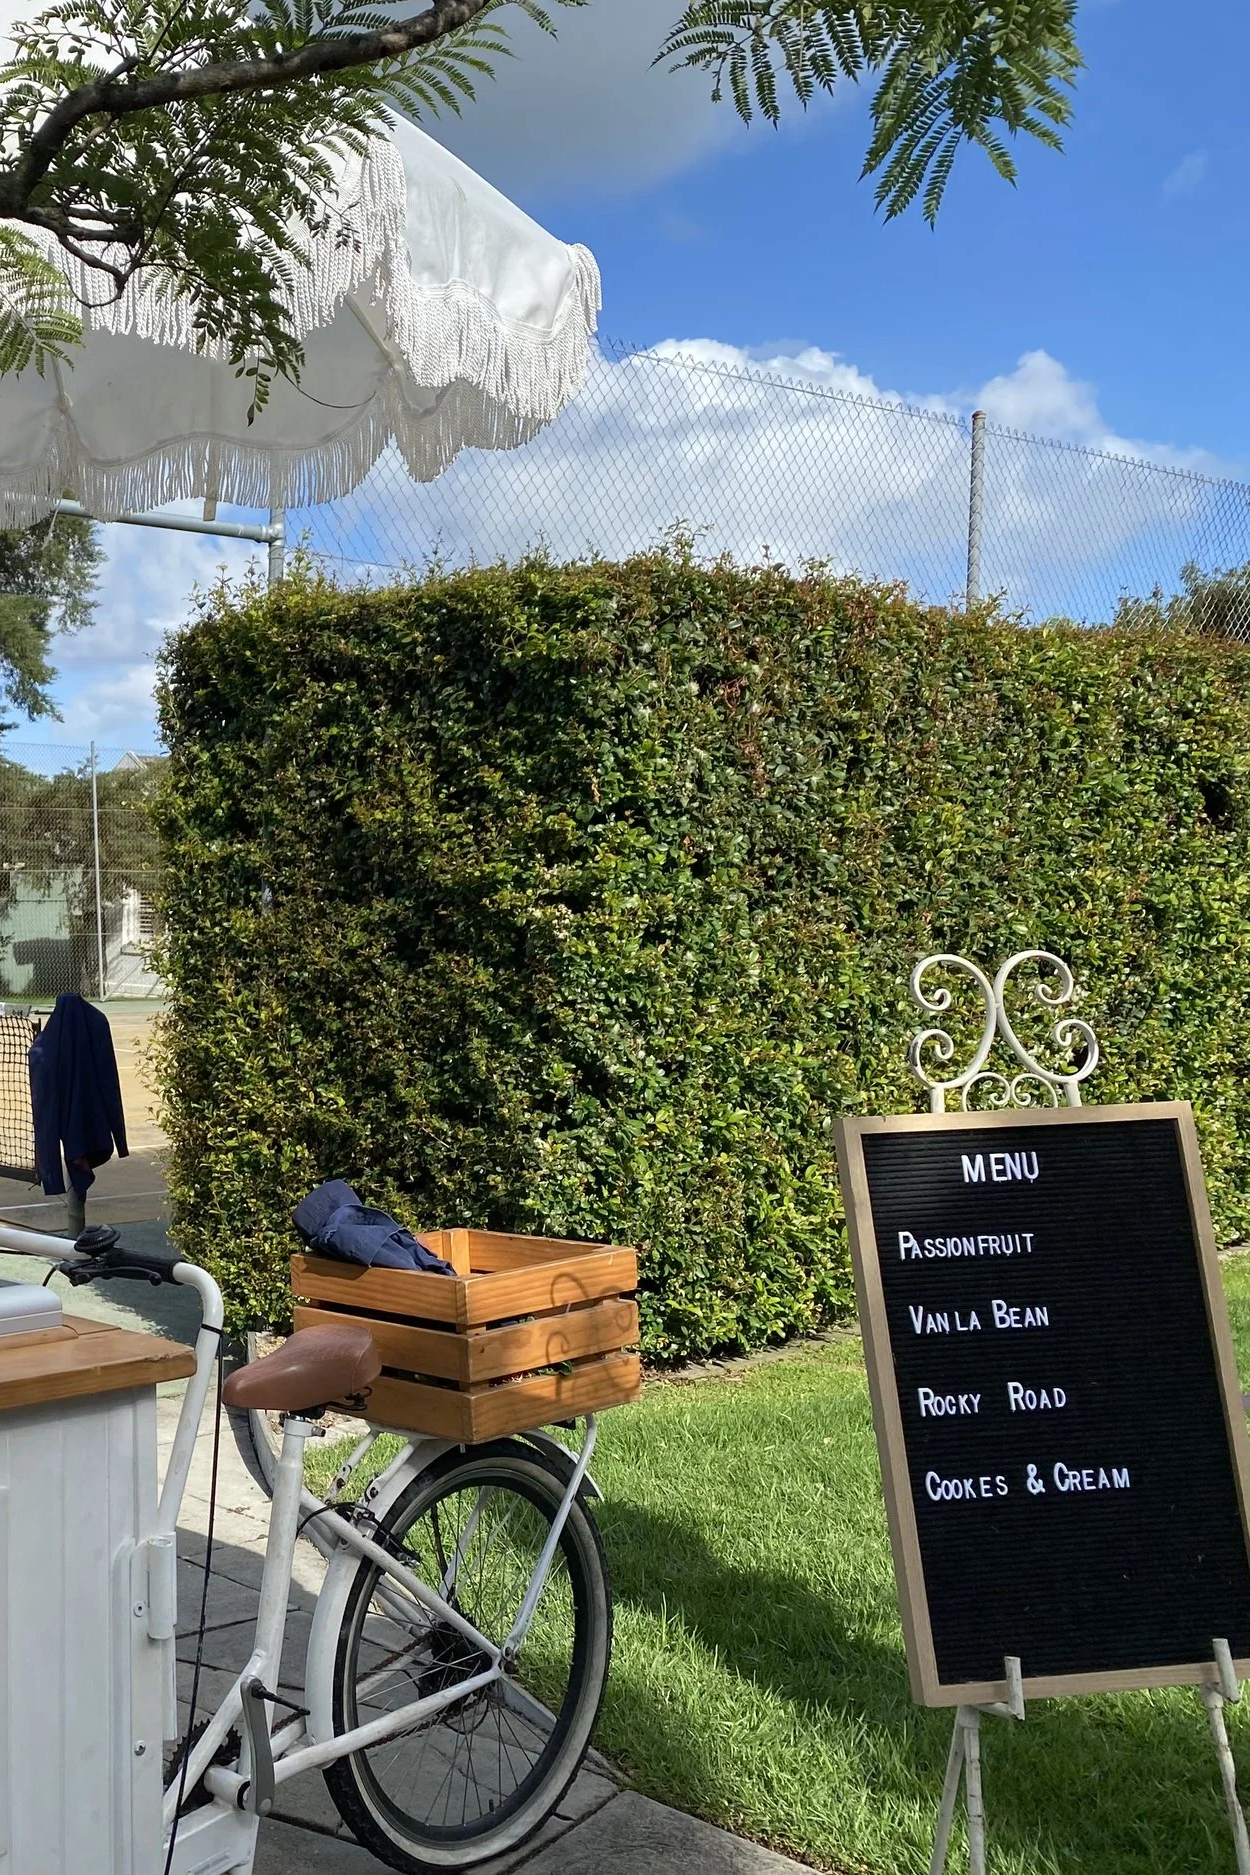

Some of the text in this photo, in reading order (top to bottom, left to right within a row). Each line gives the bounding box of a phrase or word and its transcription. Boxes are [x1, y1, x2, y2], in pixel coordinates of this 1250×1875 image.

[961, 1151, 1039, 1183] MENU
[898, 1231, 1034, 1261] PASSIONFRUIT
[991, 1299, 1049, 1329] BEAN
[917, 1381, 1067, 1417] ROCKY ROAD
[1026, 1463, 1045, 1495] &
[1053, 1462, 1130, 1492] CREAM
